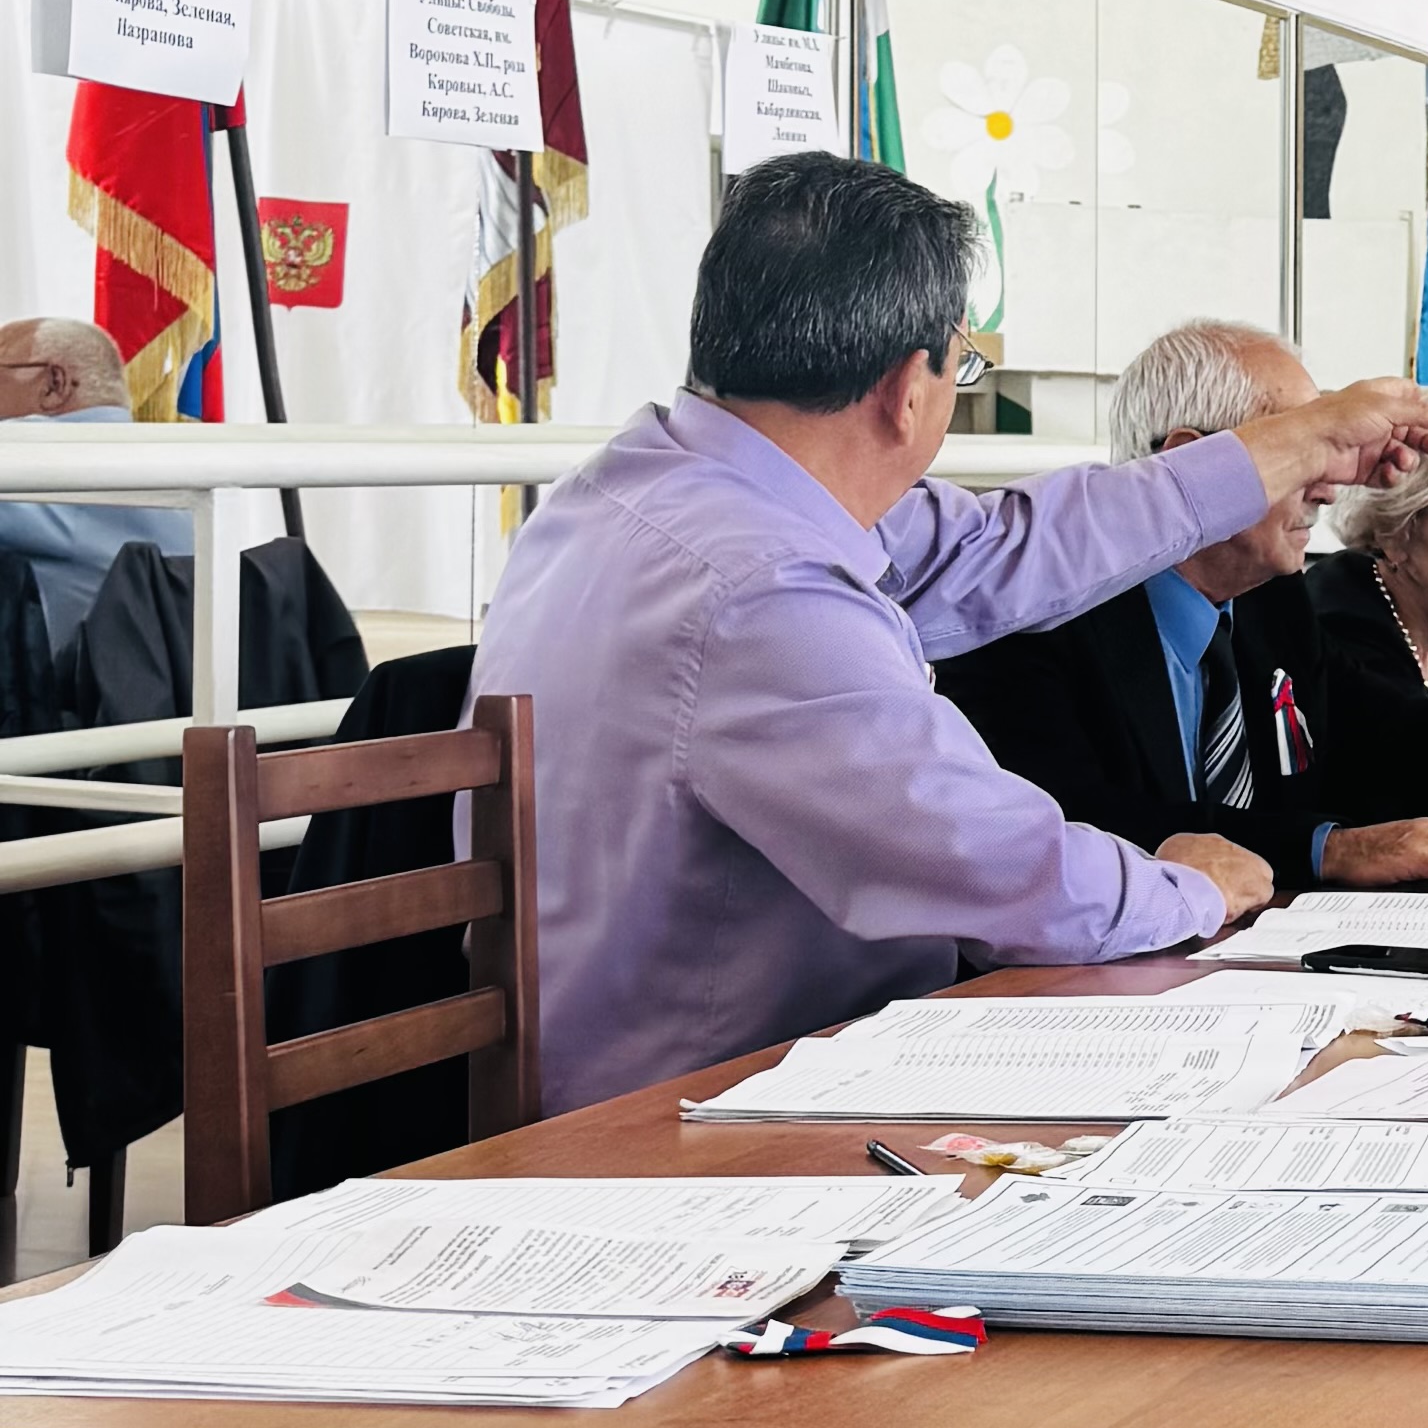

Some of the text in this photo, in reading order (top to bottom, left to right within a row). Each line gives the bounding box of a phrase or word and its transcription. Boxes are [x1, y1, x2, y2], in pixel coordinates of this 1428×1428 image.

[117, 17, 194, 49] Назранова
[427, 16, 493, 42] Советская,
[409, 42, 469, 65] Ворокова
[489, 82, 514, 98] А.С.
[422, 100, 519, 126] Кярова, Зеленая
